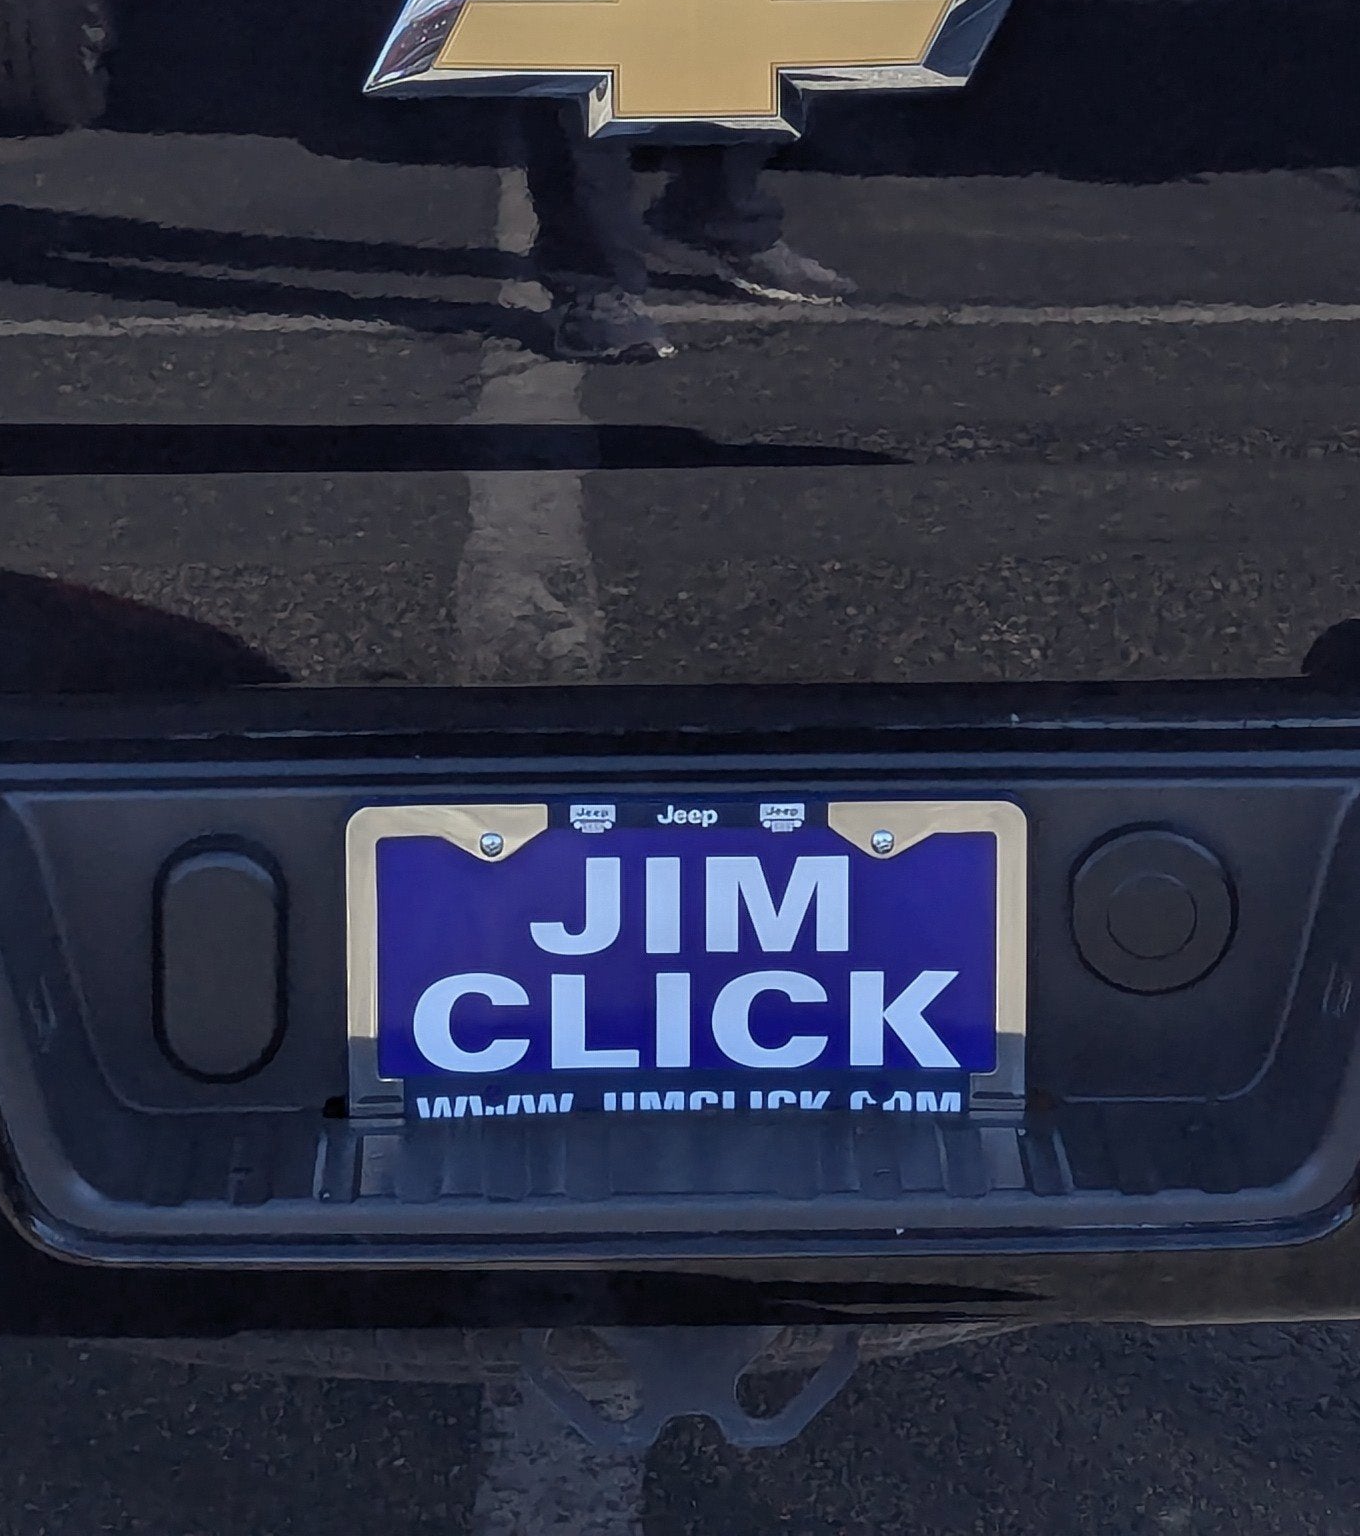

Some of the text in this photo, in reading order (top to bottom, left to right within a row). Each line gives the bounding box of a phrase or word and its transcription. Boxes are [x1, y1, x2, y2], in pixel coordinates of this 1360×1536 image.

[575, 806, 611, 818] Jeep
[657, 804, 718, 828] Jeep
[529, 855, 850, 955] JIM
[412, 969, 962, 1073] CLICK
